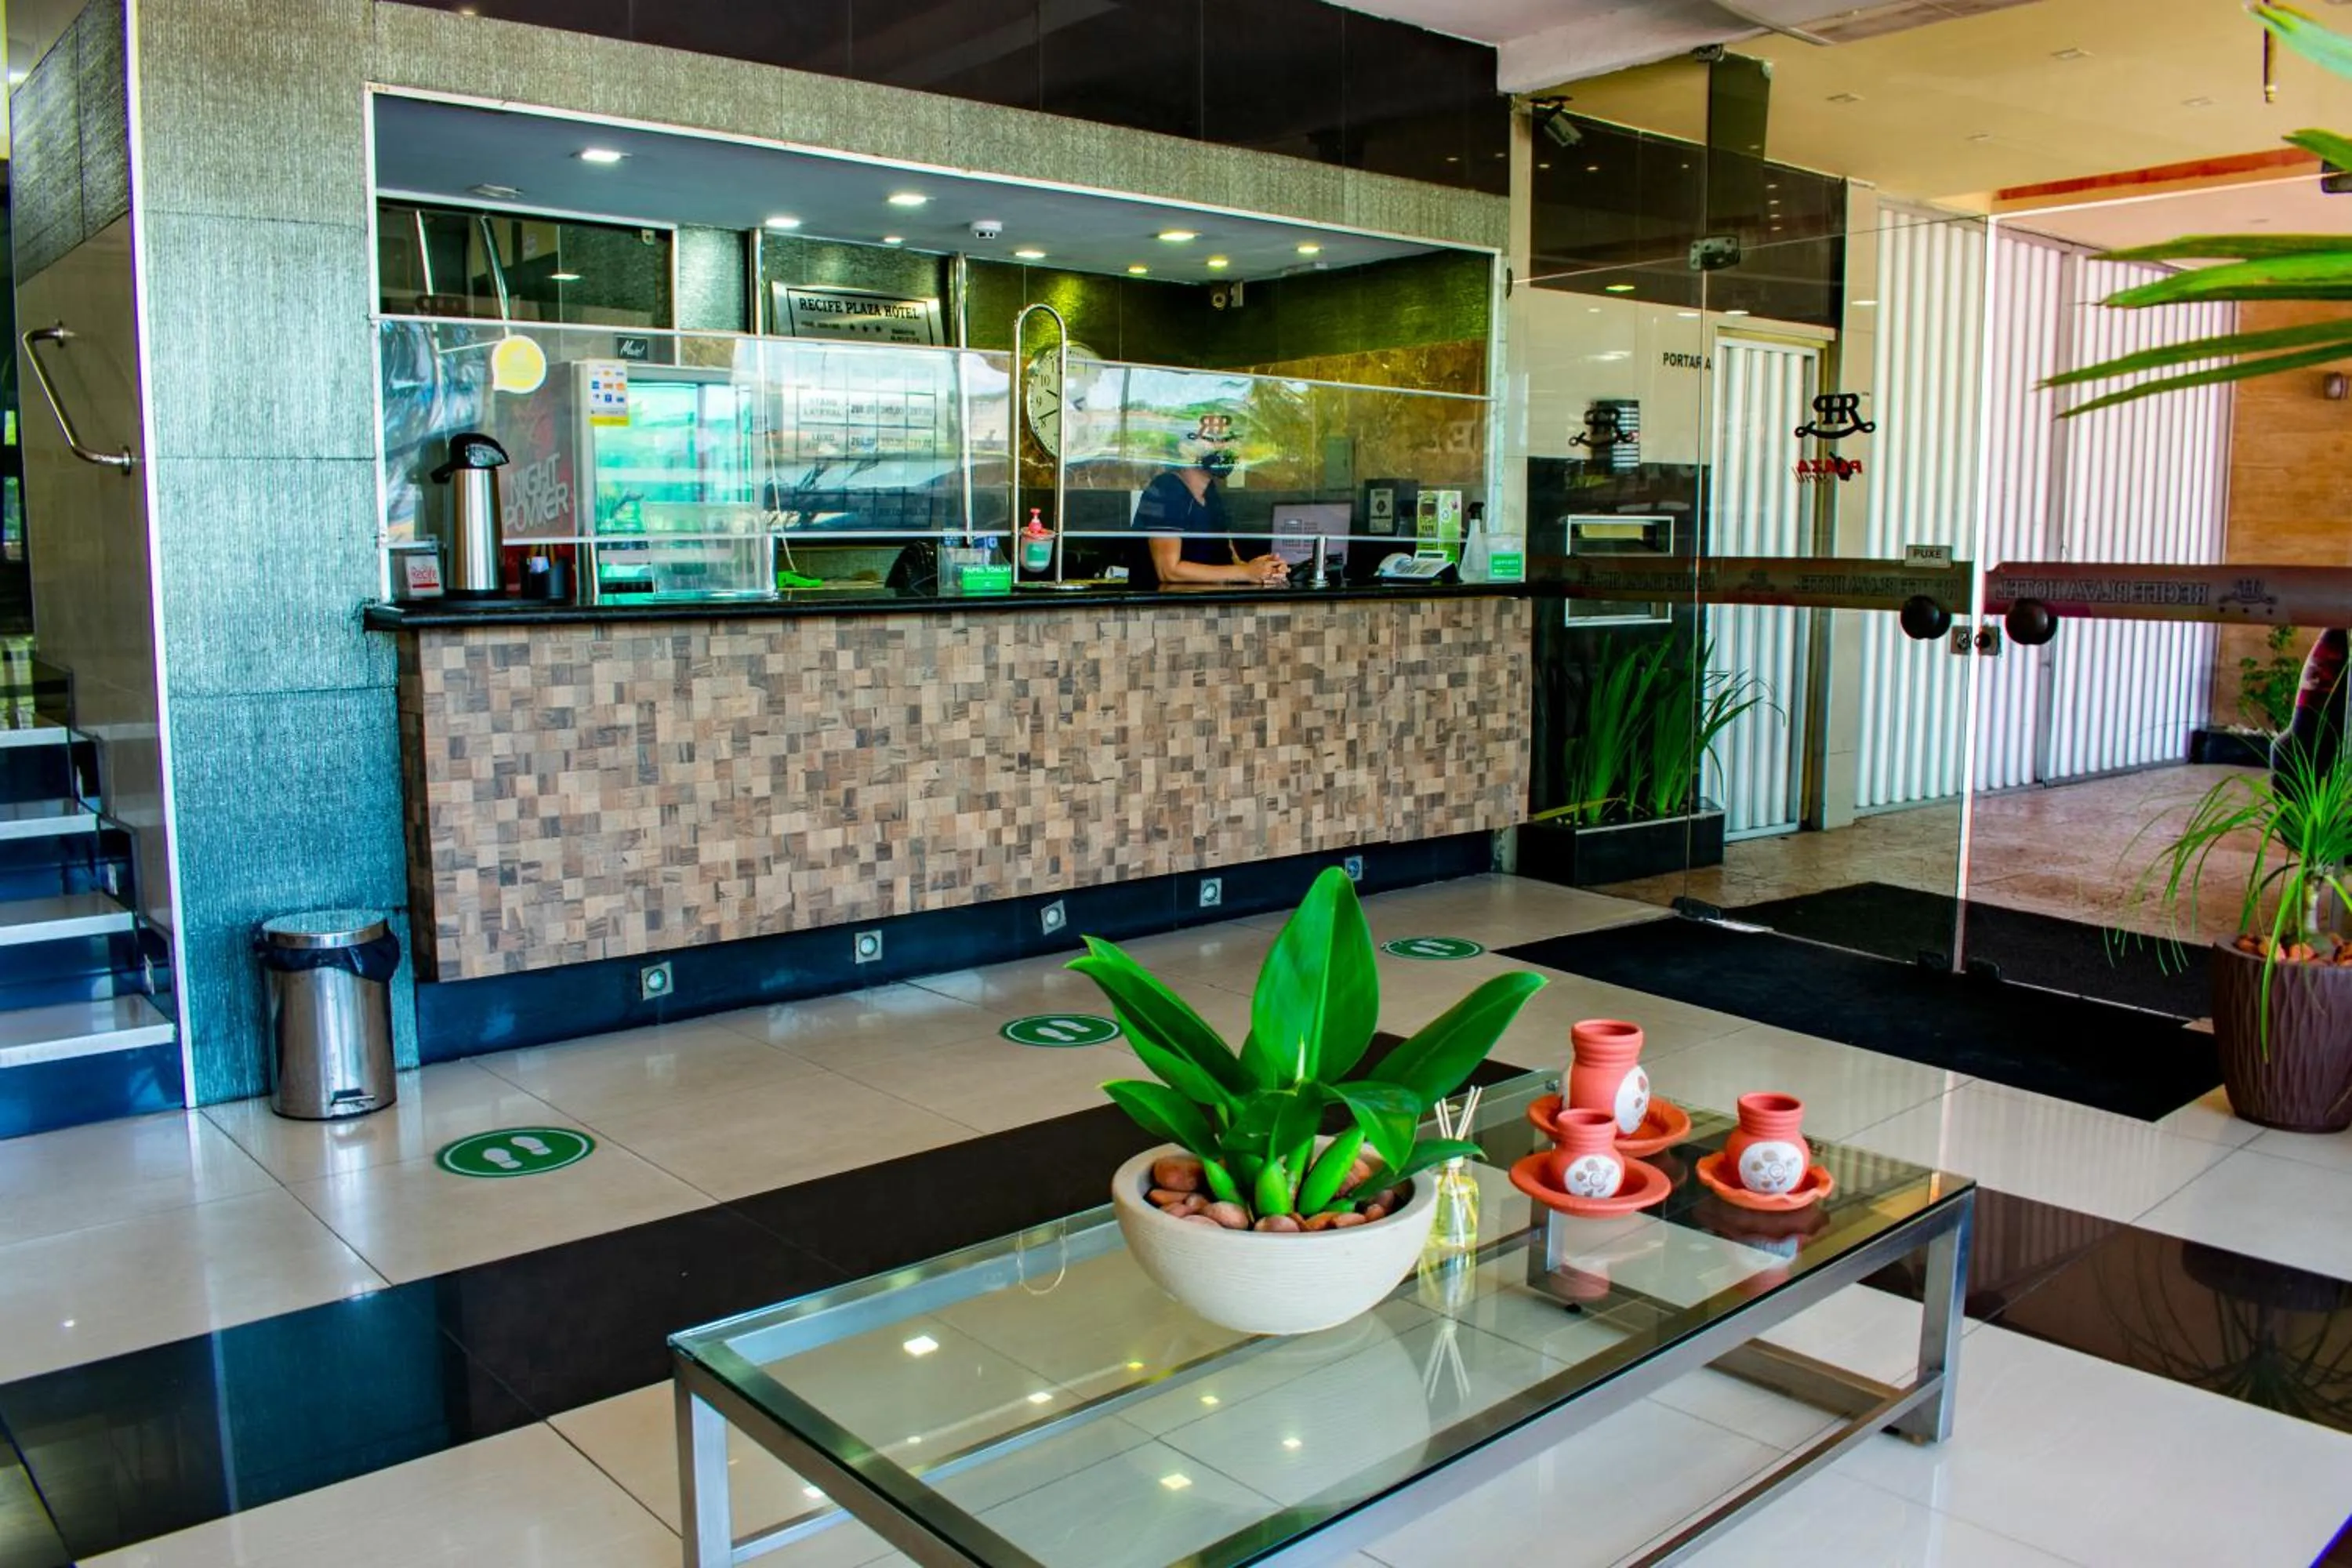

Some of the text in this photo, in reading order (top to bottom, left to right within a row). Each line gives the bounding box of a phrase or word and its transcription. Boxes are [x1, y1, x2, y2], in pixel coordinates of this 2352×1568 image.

[800, 297, 920, 320] RECIFE PLAZA HOTEL
[510, 452, 561, 506] NIGHT
[504, 481, 569, 534] POWER
[1913, 548, 1942, 559] PUXE
